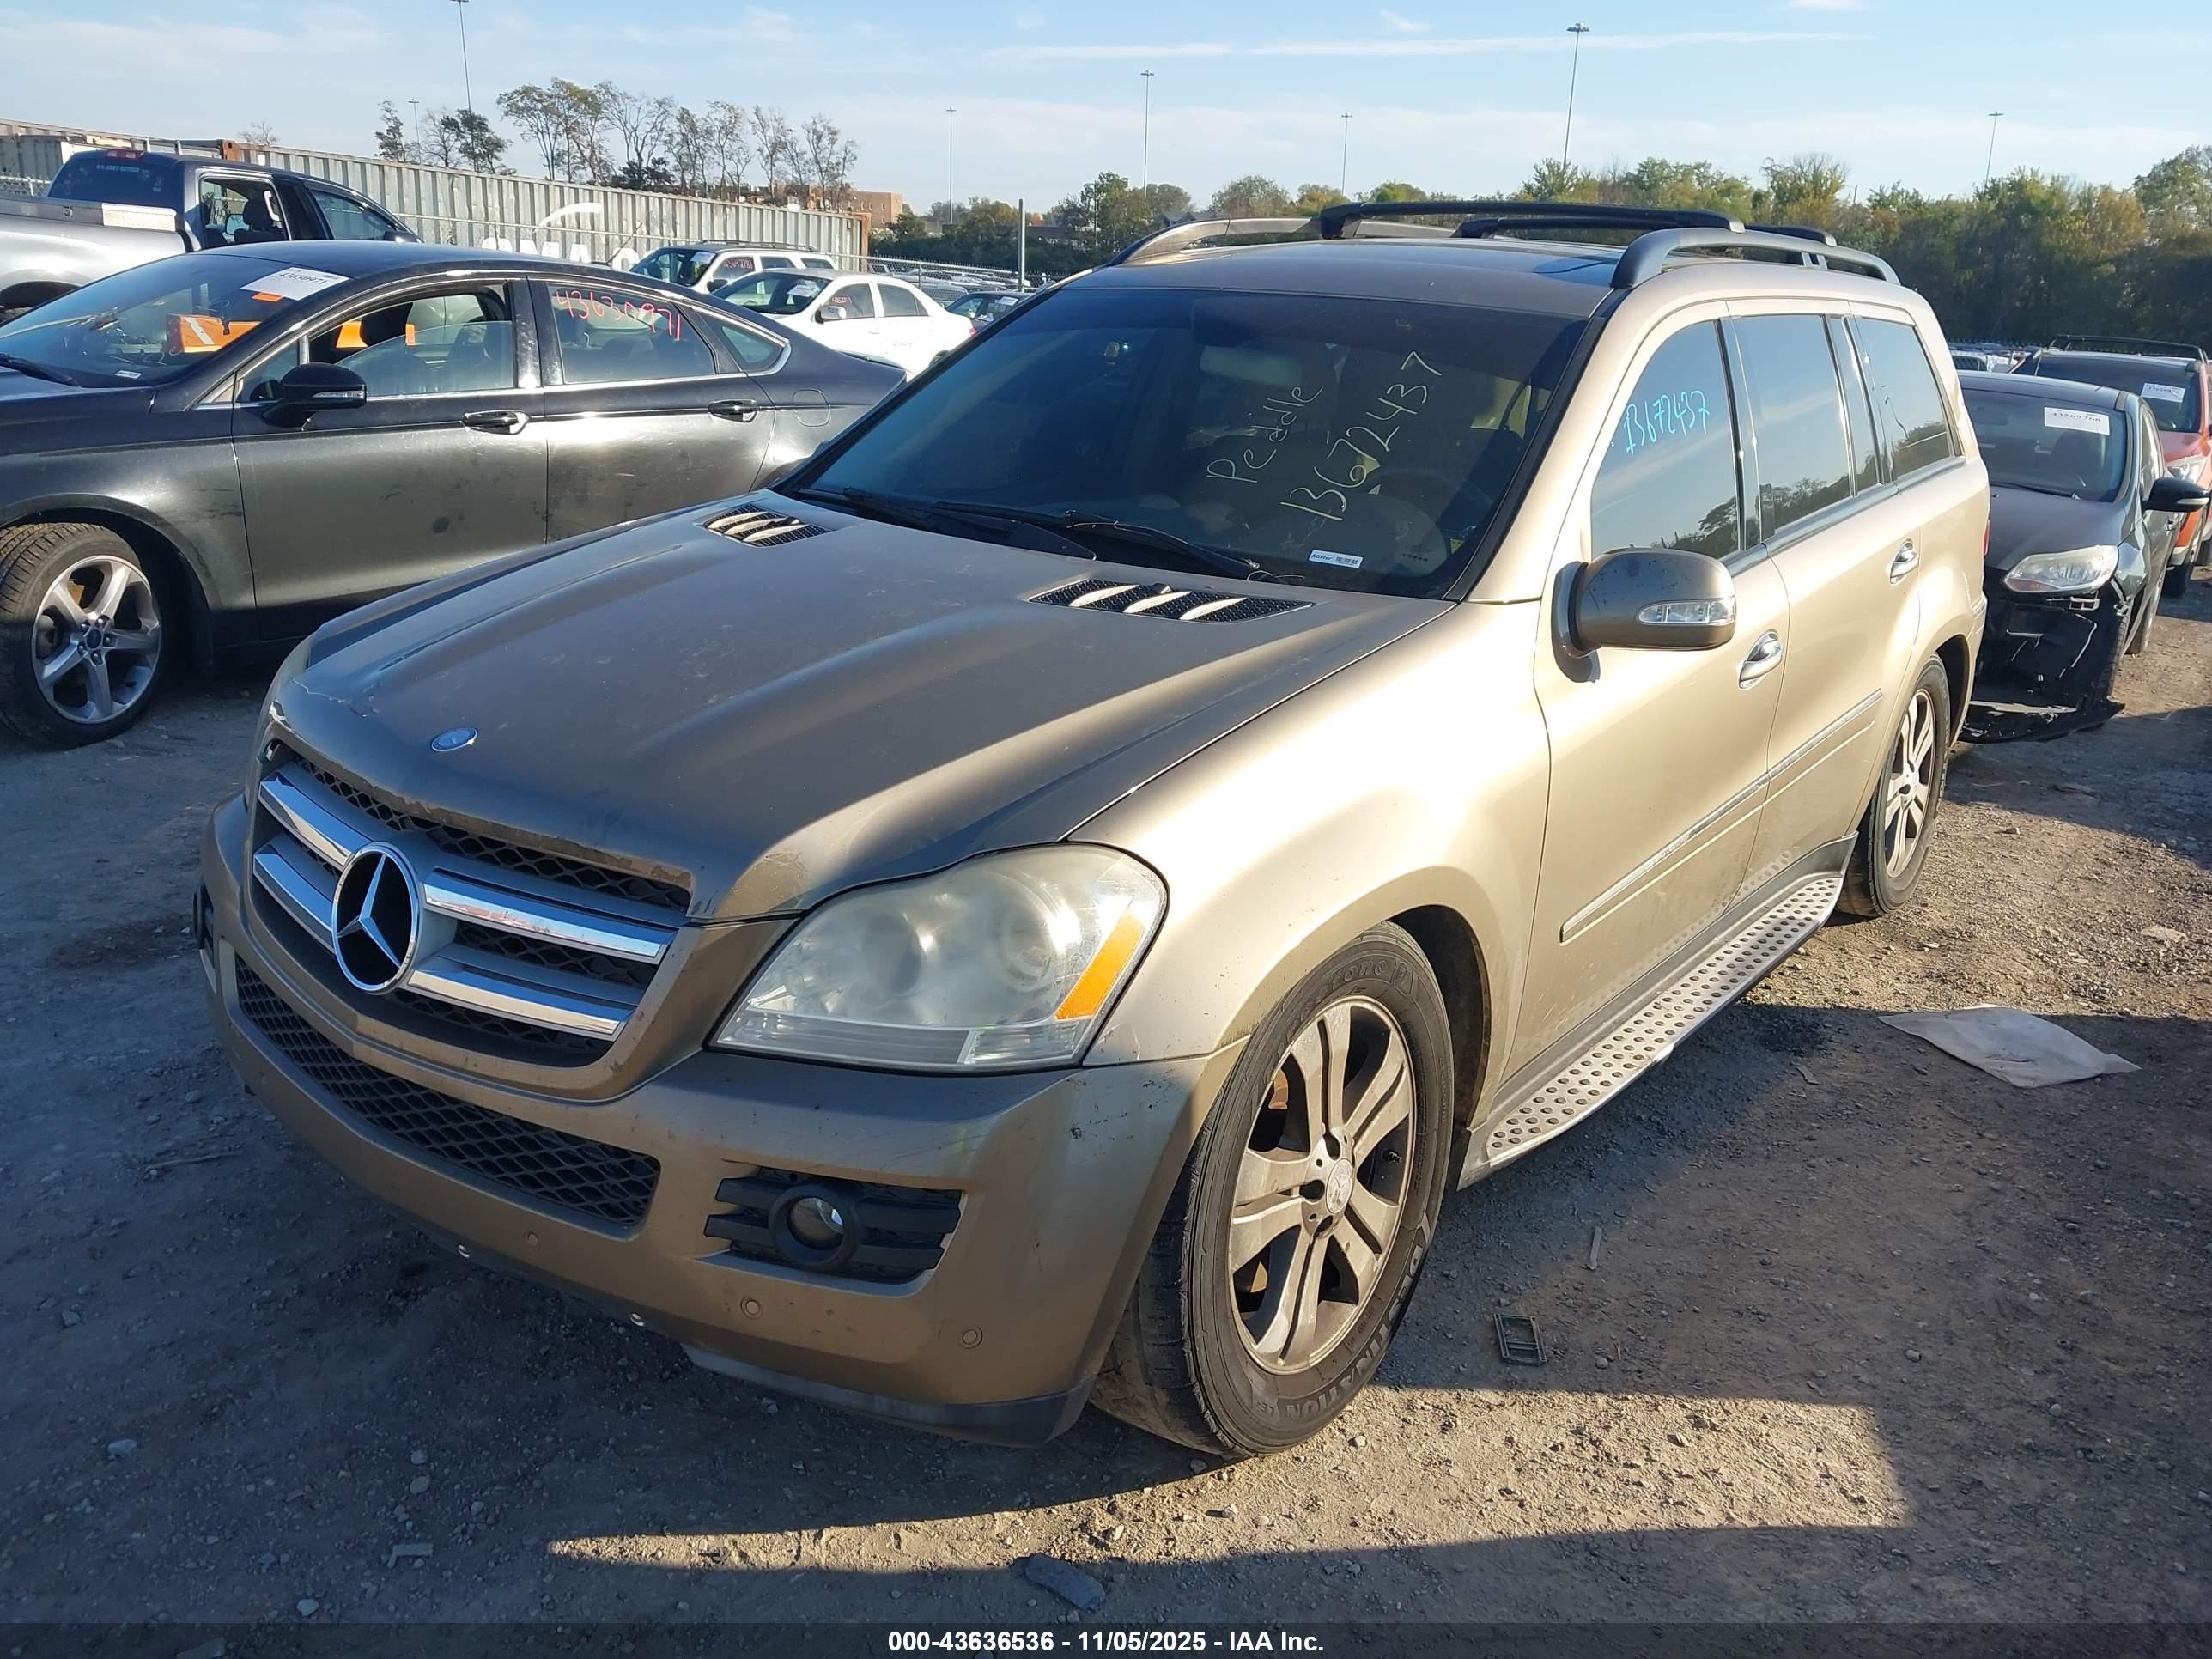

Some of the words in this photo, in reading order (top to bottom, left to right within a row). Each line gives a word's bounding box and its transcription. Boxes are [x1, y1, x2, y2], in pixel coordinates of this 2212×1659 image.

[556, 290, 682, 343] 43630971
[1206, 386, 1324, 483] Peddle
[1279, 350, 1443, 520] 13672437
[1284, 1244, 1424, 1420] DESTINATION
